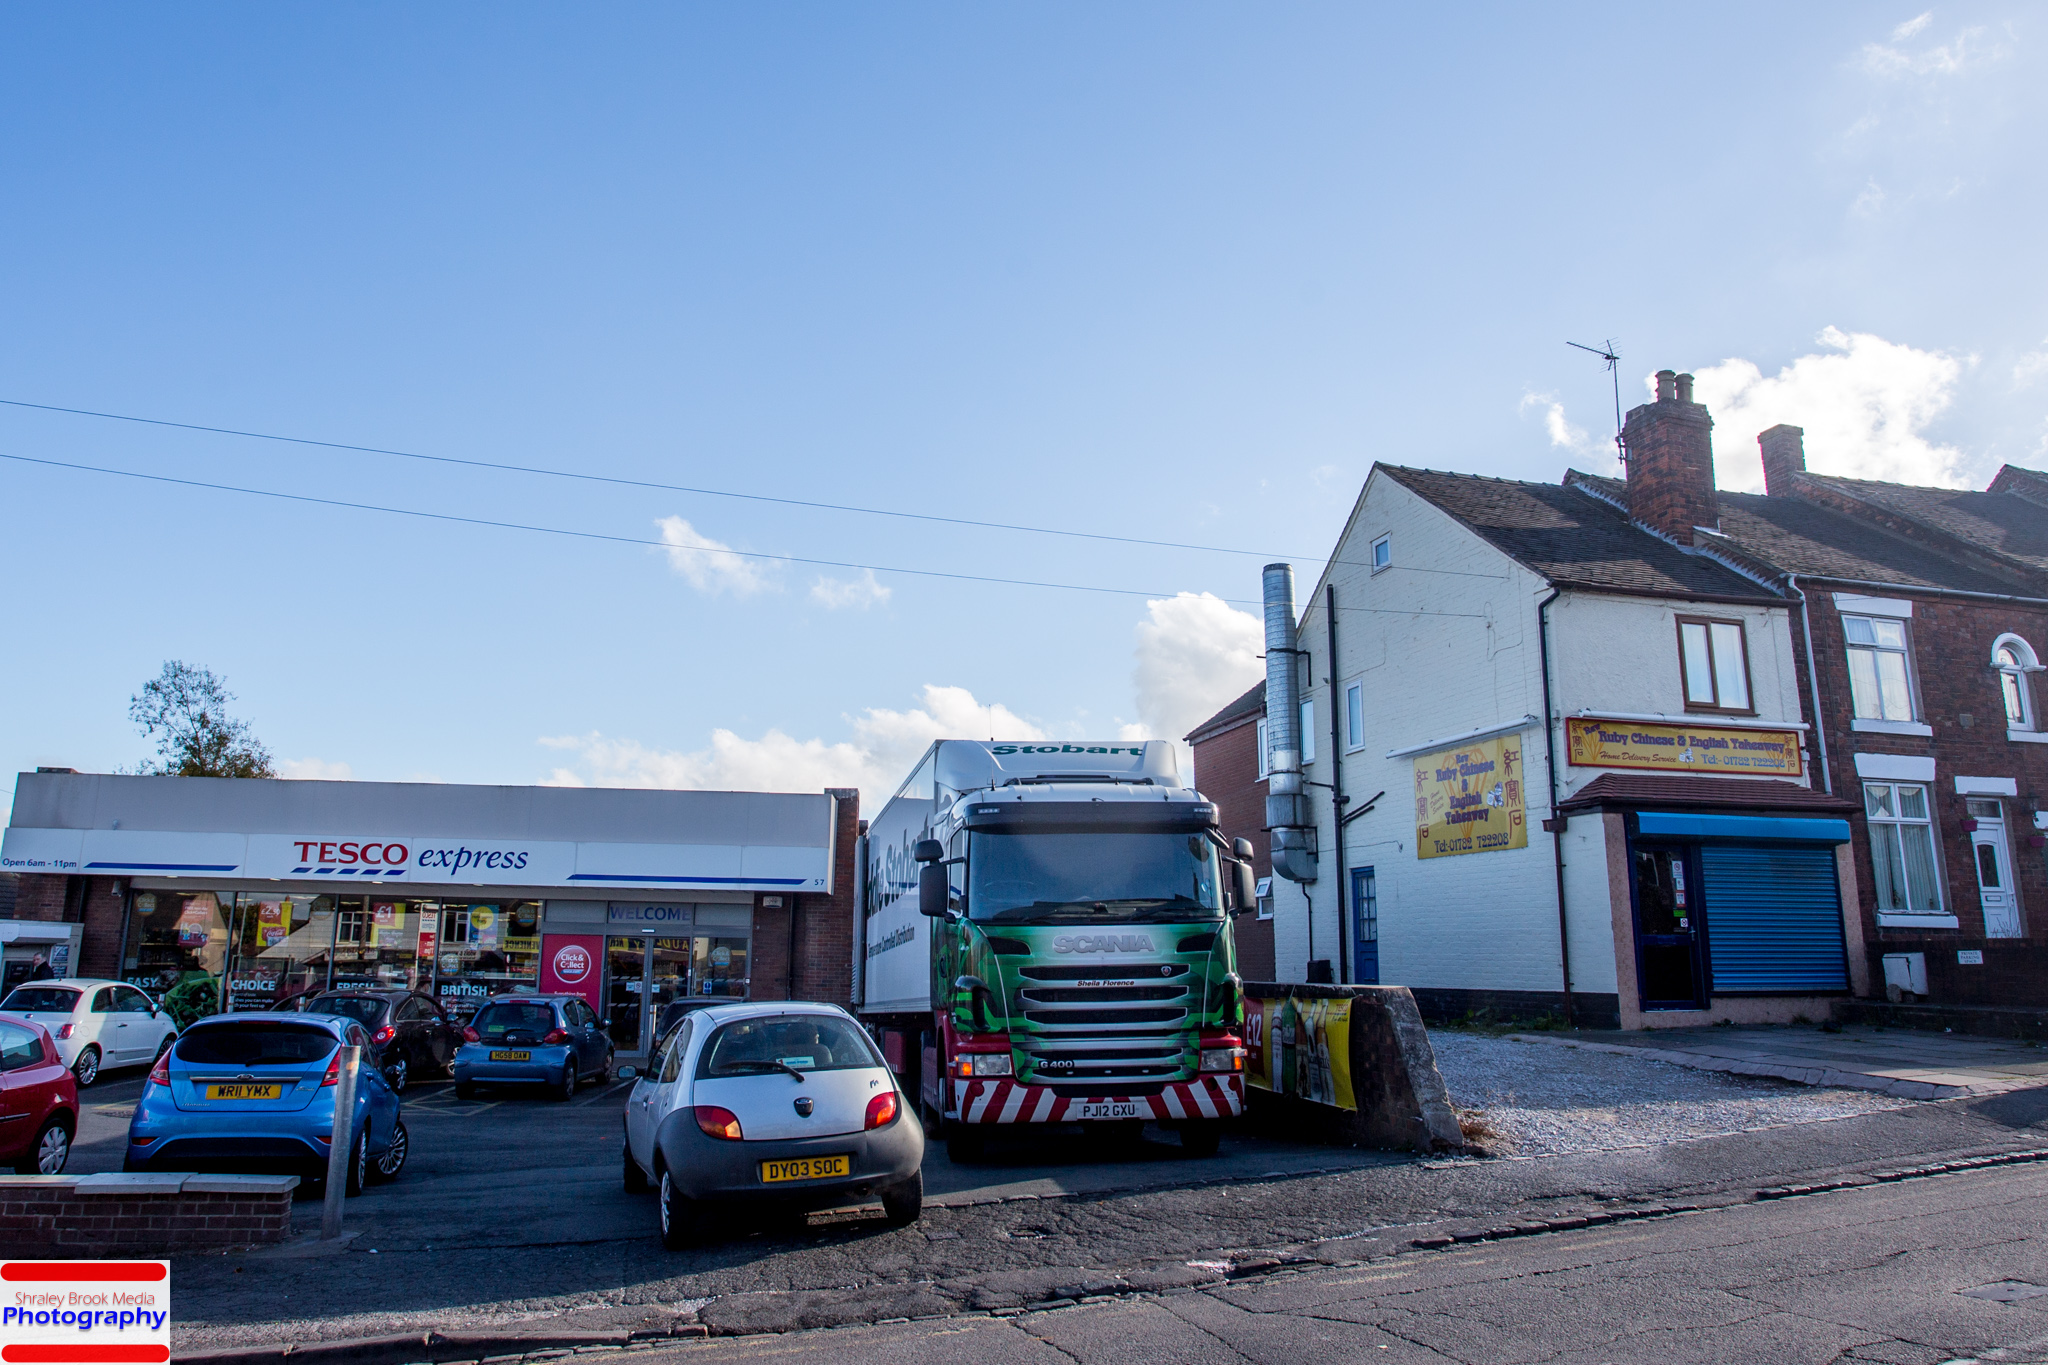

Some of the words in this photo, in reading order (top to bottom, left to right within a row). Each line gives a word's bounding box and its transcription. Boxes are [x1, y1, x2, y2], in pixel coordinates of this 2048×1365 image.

[1598, 731, 1628, 746] Ruby
[1631, 733, 1675, 746] Chinese
[1677, 735, 1686, 747] &
[1688, 736, 1729, 750] English
[992, 744, 1143, 756] Stobart
[1599, 751, 1621, 760] Home
[1621, 752, 1650, 763] Delivery
[1652, 753, 1676, 763] Service
[1723, 755, 1750, 767] 01782
[1751, 757, 1785, 768] 722208
[1436, 766, 1457, 782] Ruby
[1460, 760, 1495, 777] Chinese
[1461, 779, 1468, 792] &
[1450, 791, 1482, 810] English
[1476, 832, 1510, 849] 722208
[2, 858, 26, 868] Open
[27, 859, 46, 867] 6am
[54, 860, 77, 869] 11pm
[294, 842, 409, 865] TESCO
[418, 846, 529, 875] express
[376, 905, 392, 918] £1
[610, 906, 691, 921] WELCOME
[1052, 935, 1156, 953] SCANIA
[560, 953, 577, 961] Click
[127, 977, 158, 987] EASY
[231, 980, 275, 990] CHOICE
[441, 985, 488, 996] BRITISH
[1246, 1014, 1262, 1047] £12
[1050, 1060, 1073, 1068] 400
[217, 1086, 243, 1098] WR11
[245, 1085, 271, 1097] YMX
[1083, 1105, 1110, 1117] PJ12
[1112, 1104, 1135, 1116] GXU
[769, 1163, 809, 1179] DY03
[814, 1159, 842, 1175] SOC
